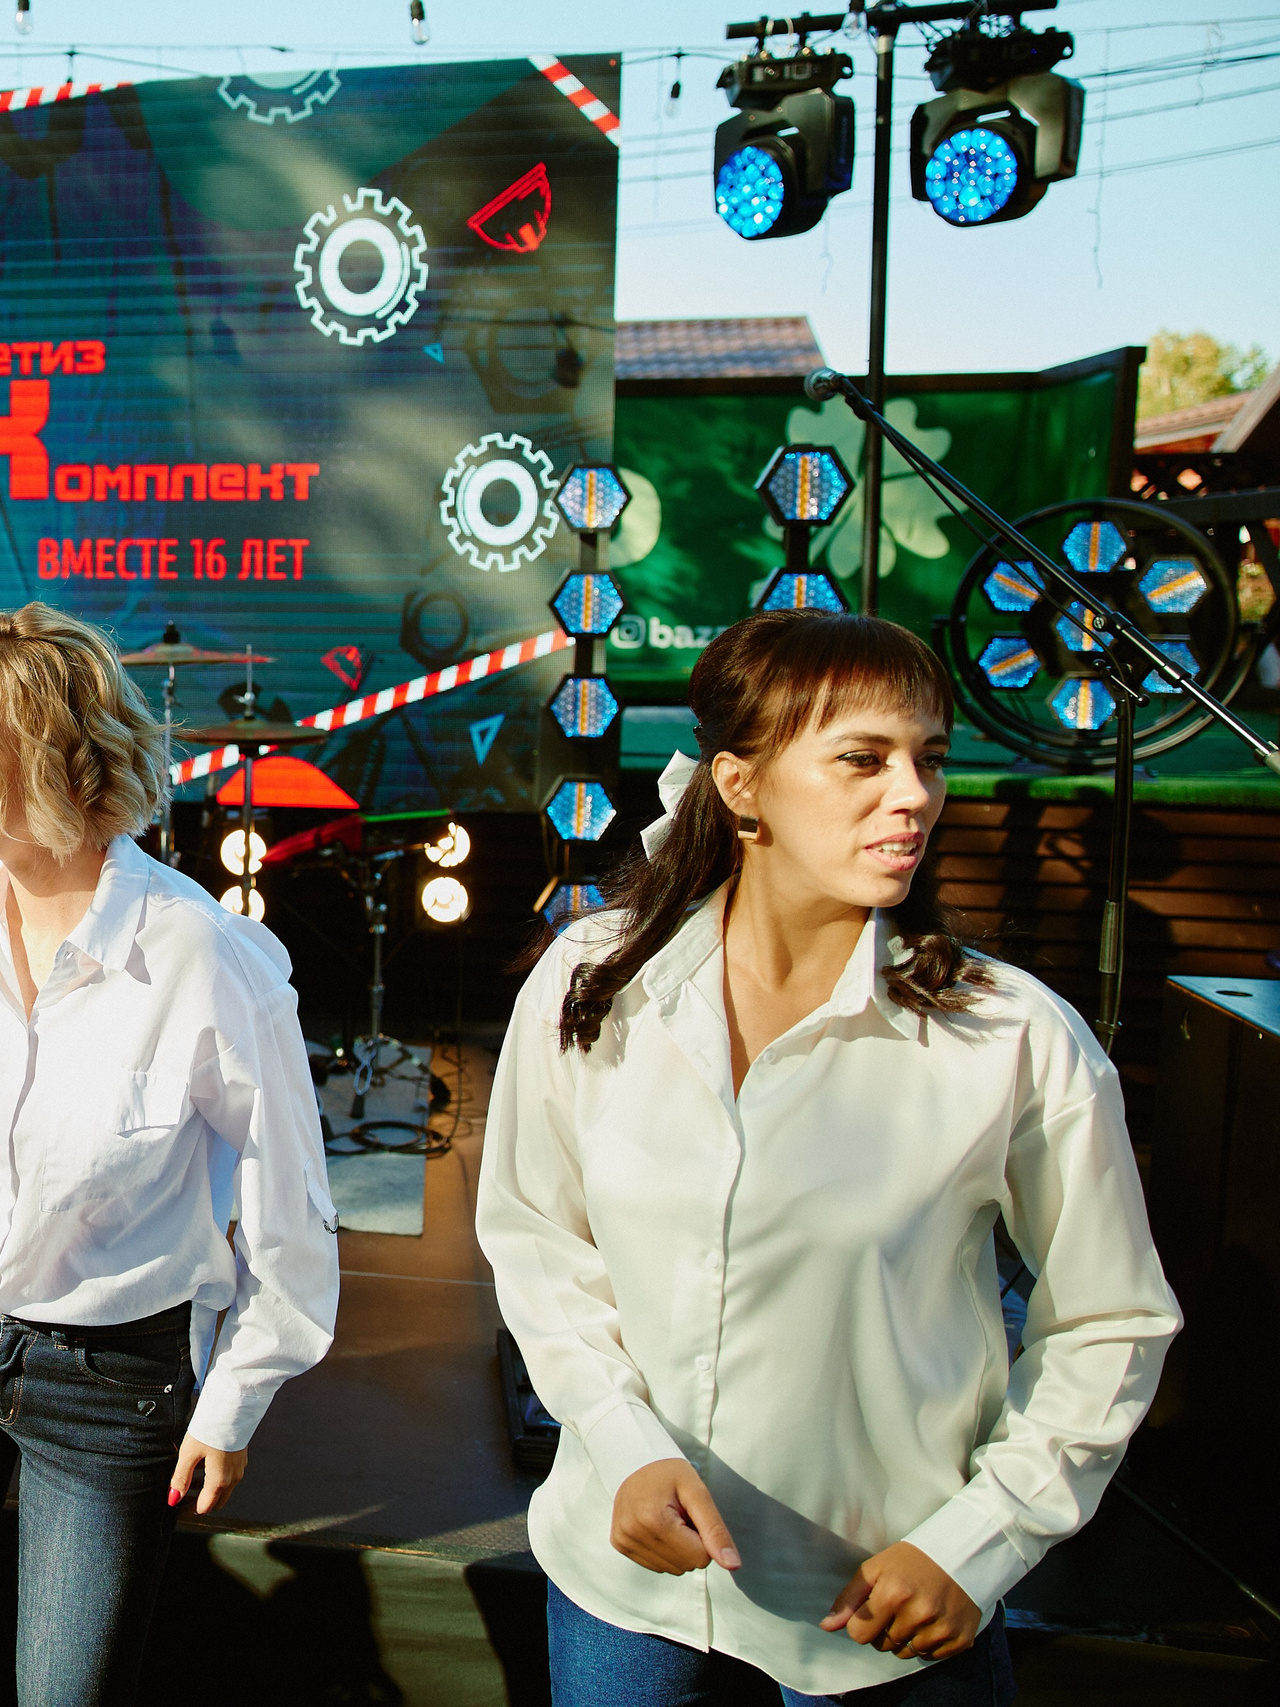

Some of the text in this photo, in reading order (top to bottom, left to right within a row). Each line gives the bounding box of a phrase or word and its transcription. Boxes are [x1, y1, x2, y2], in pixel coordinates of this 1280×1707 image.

[37, 538, 310, 580] ВМЕСТЕ 16 ЛЕТ
